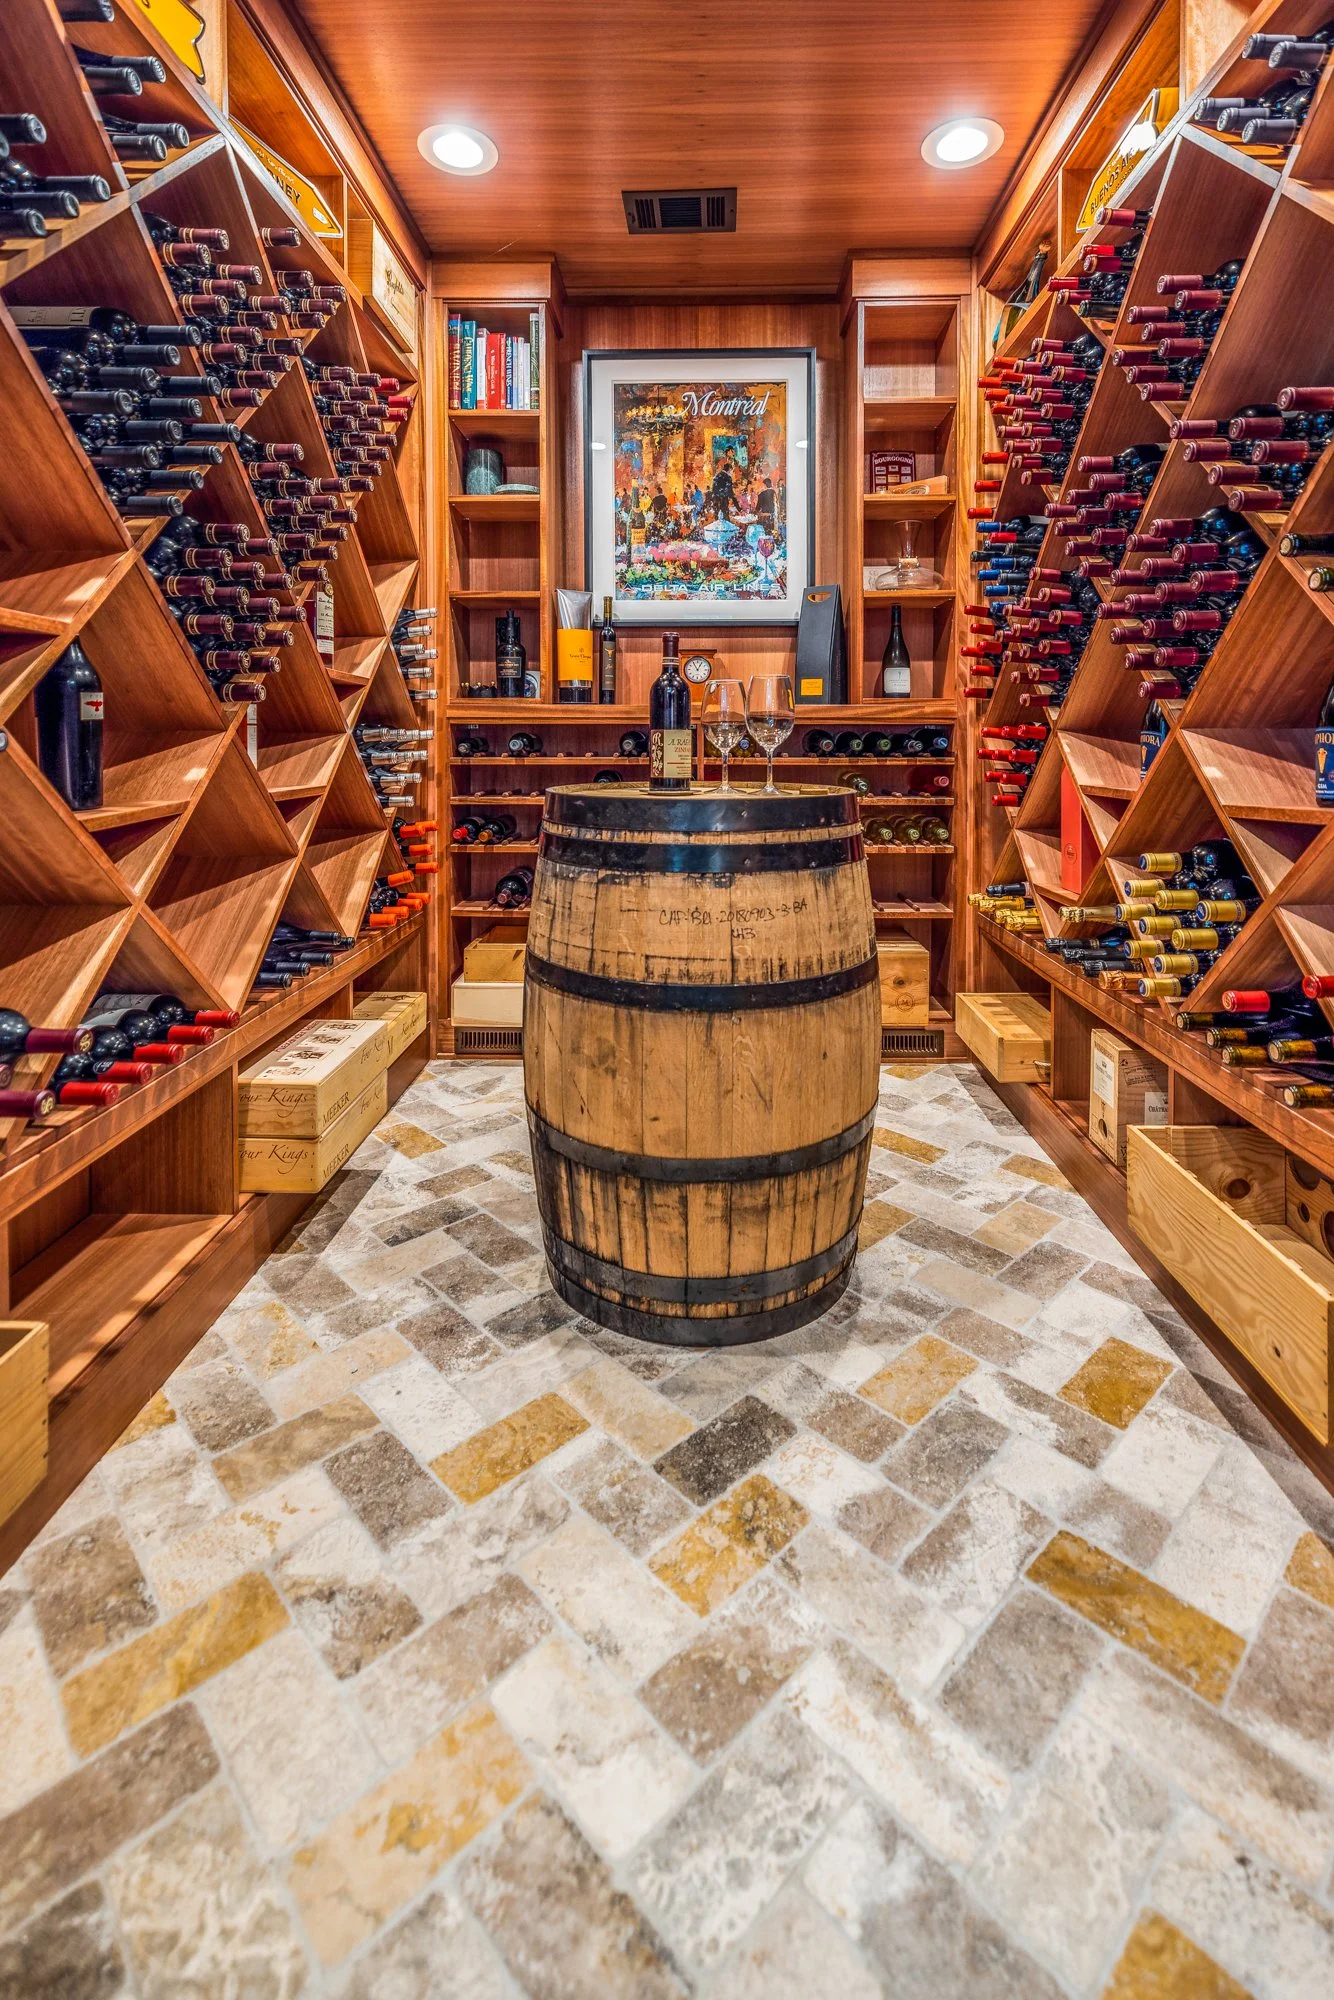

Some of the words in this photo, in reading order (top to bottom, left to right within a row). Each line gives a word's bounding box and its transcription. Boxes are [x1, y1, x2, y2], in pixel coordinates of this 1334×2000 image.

[1090, 170, 1119, 214] BUENOS
[667, 390, 770, 417] Montréal
[874, 455, 914, 465] BOURGOGNE
[641, 583, 688, 592] DELTA
[699, 583, 725, 592] AIR
[733, 583, 781, 592] LINES
[239, 1092, 263, 1102] our
[267, 1088, 308, 1118] Kings
[322, 1091, 349, 1128] MEEKER
[239, 1148, 263, 1159] our
[267, 1144, 309, 1174] Kings
[322, 1142, 349, 1183] MEEKER
